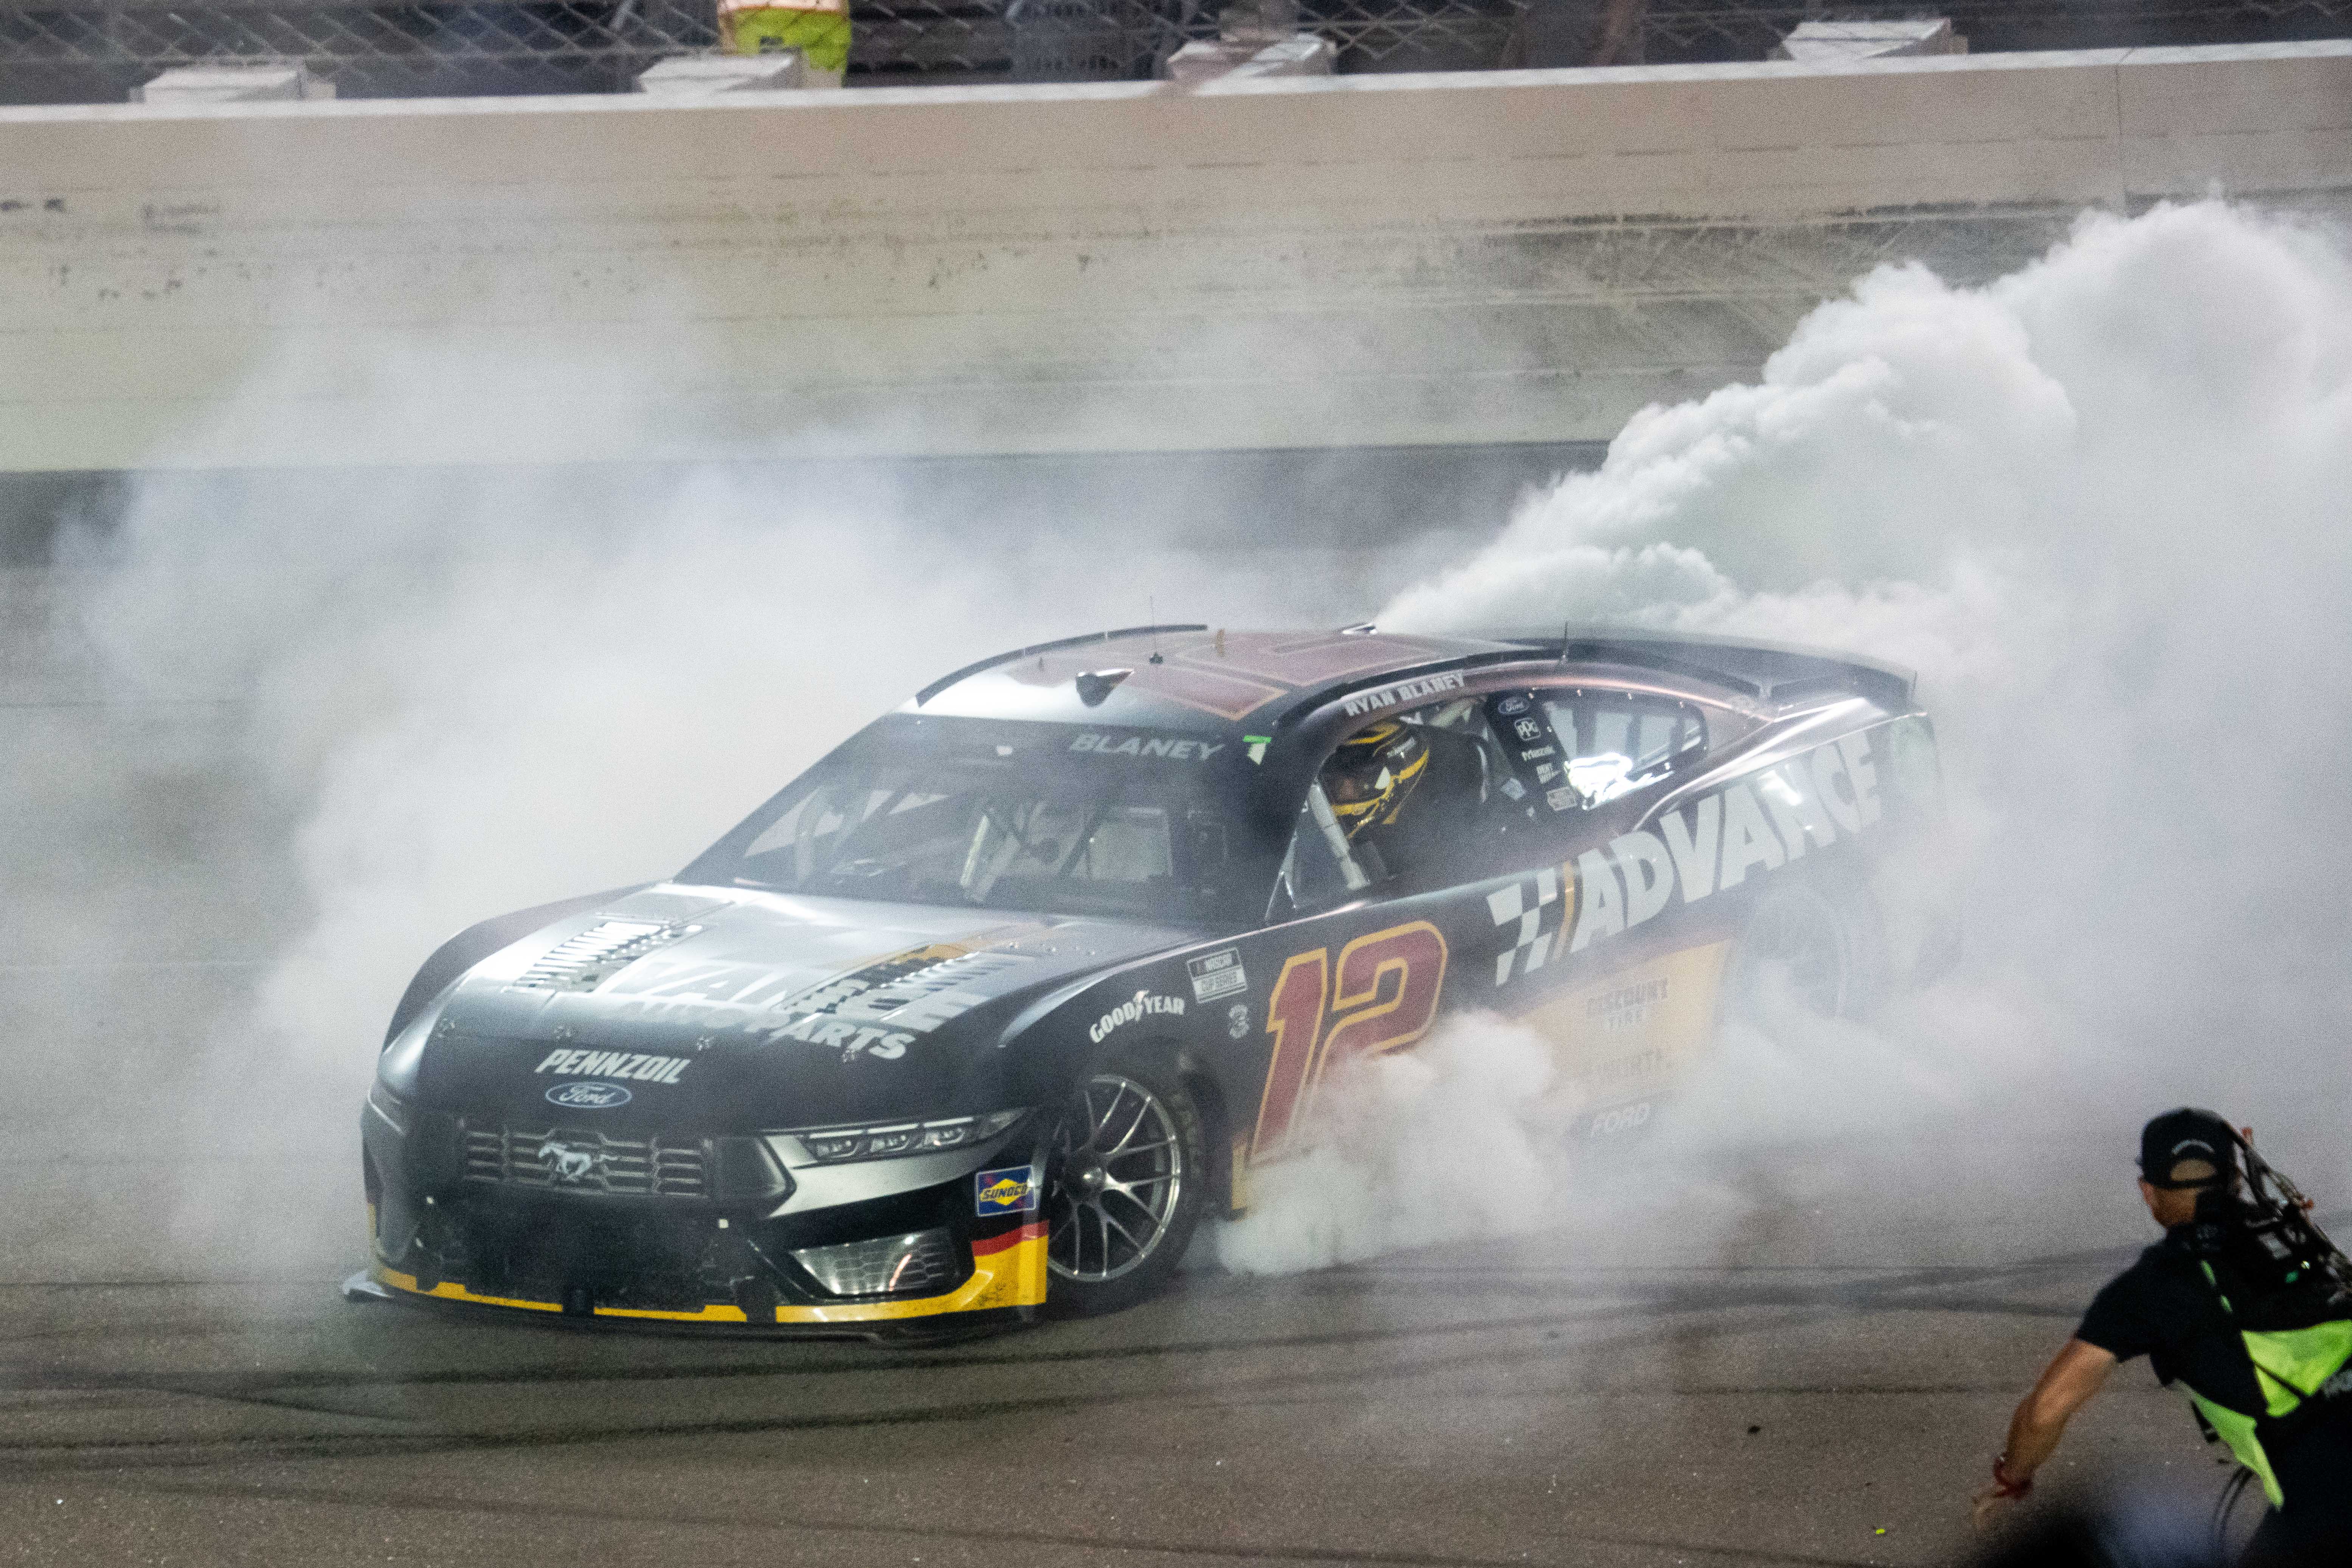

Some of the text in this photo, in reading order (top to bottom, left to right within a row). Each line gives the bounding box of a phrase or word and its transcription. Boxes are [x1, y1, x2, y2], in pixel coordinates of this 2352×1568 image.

[1344, 673, 1467, 717] RYAN BLANEY
[1069, 731, 1224, 760] BLANEY
[1570, 730, 1883, 953] ADVANCE
[743, 1012, 915, 1060] PARTS
[1089, 990, 1185, 1043] GOODYEAR
[1250, 920, 1448, 1169] 12
[535, 1049, 692, 1084] PENNZOIL
[559, 1083, 613, 1104] Ford
[1589, 1102, 1651, 1137] FORD
[983, 1185, 1027, 1199] SUNOCO
